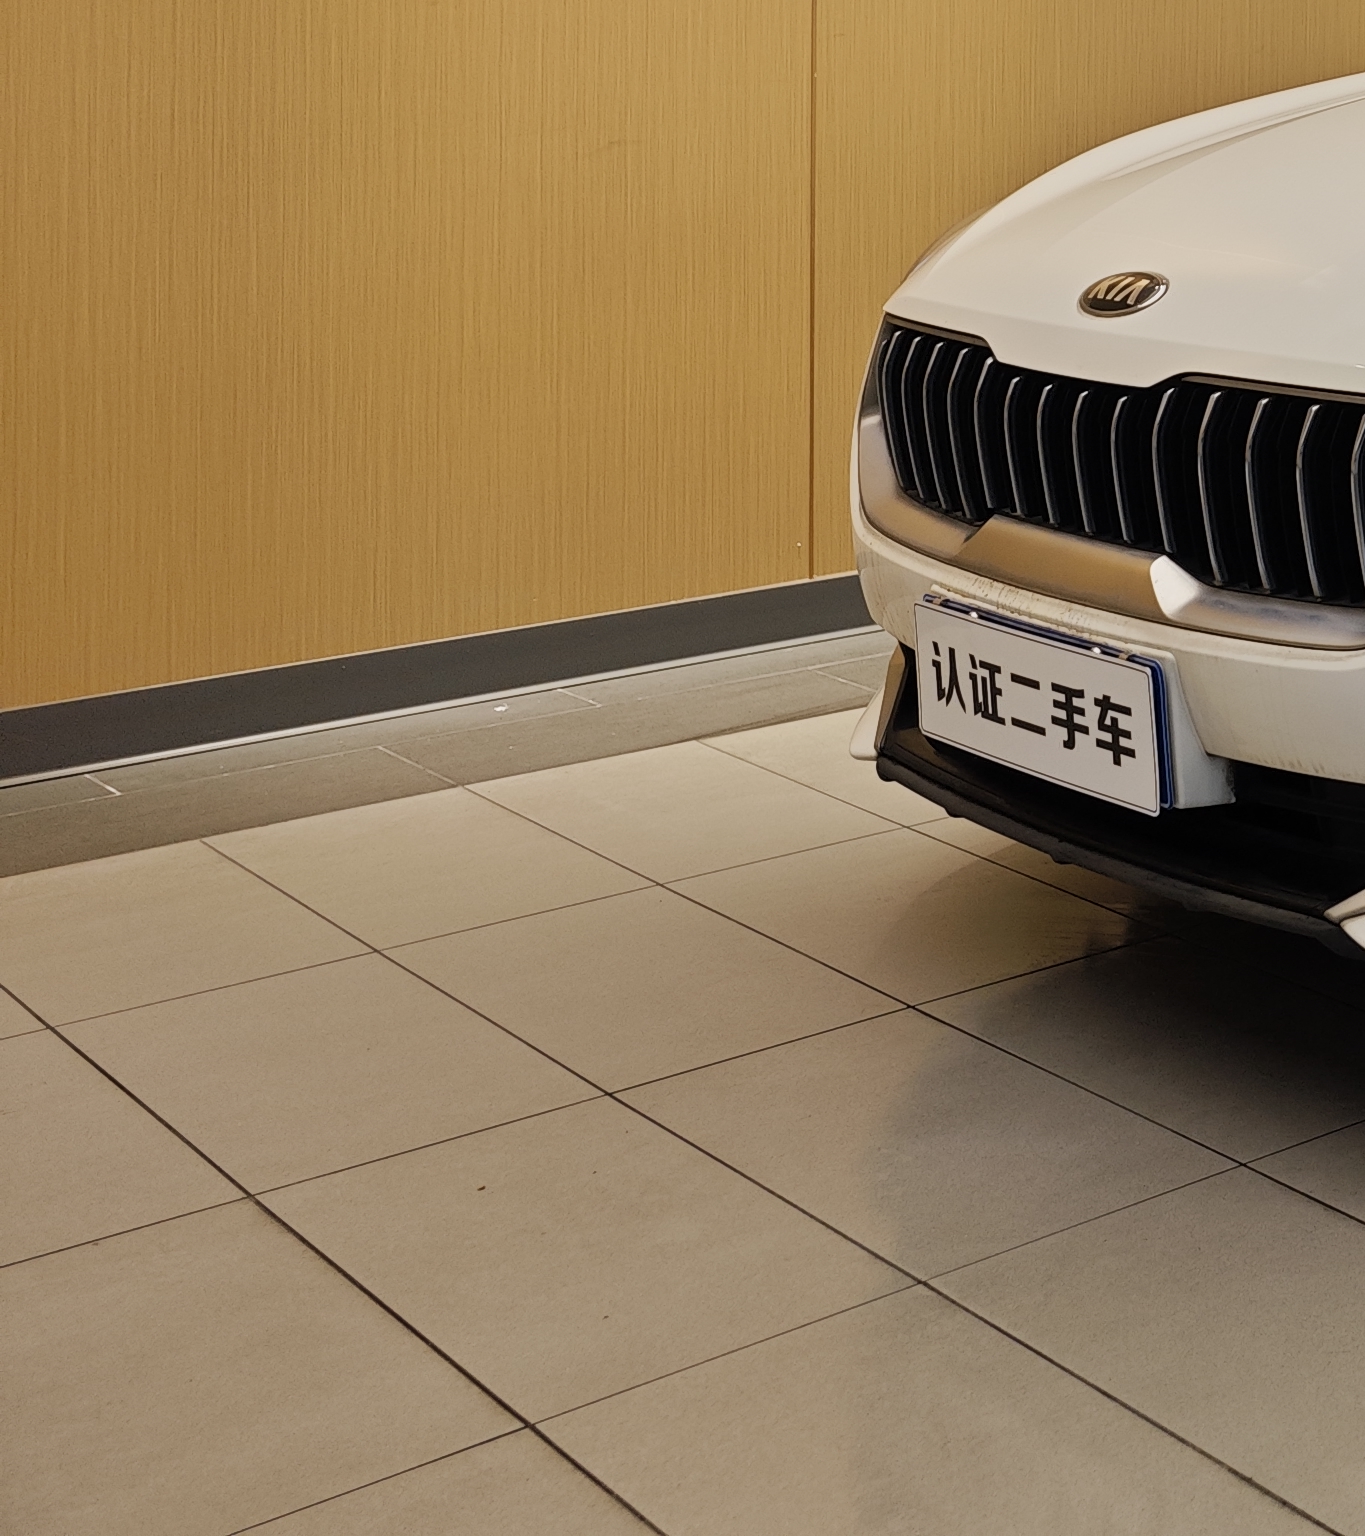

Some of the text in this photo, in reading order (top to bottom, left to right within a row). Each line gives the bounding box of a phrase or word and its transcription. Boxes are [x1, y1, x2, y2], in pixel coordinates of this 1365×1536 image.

[1087, 275, 1151, 306] KIA
[931, 640, 1136, 767] 认证二手车
